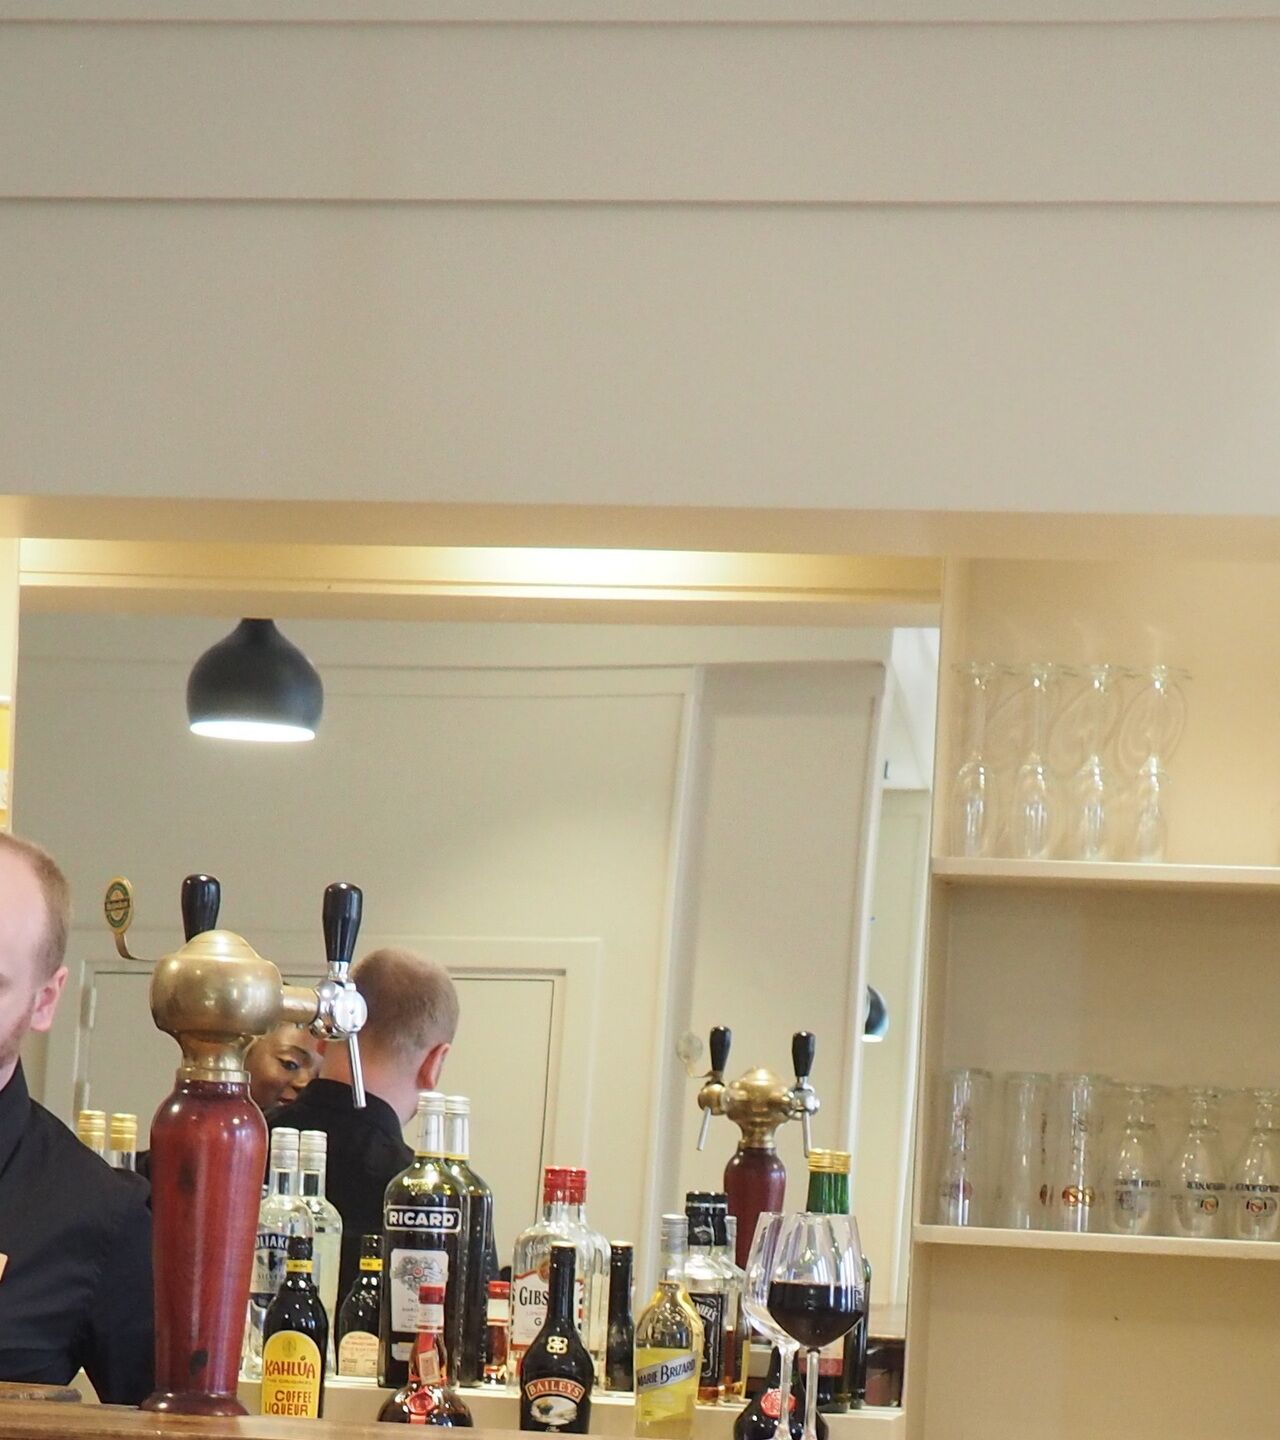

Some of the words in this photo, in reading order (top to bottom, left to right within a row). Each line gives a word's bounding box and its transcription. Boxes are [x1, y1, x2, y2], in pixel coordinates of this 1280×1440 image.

[388, 1210, 455, 1228] RICARD
[275, 1390, 312, 1404] COFFEE
[528, 1380, 583, 1398] BAILEYS
[264, 1401, 309, 1417] LIQUEUR
